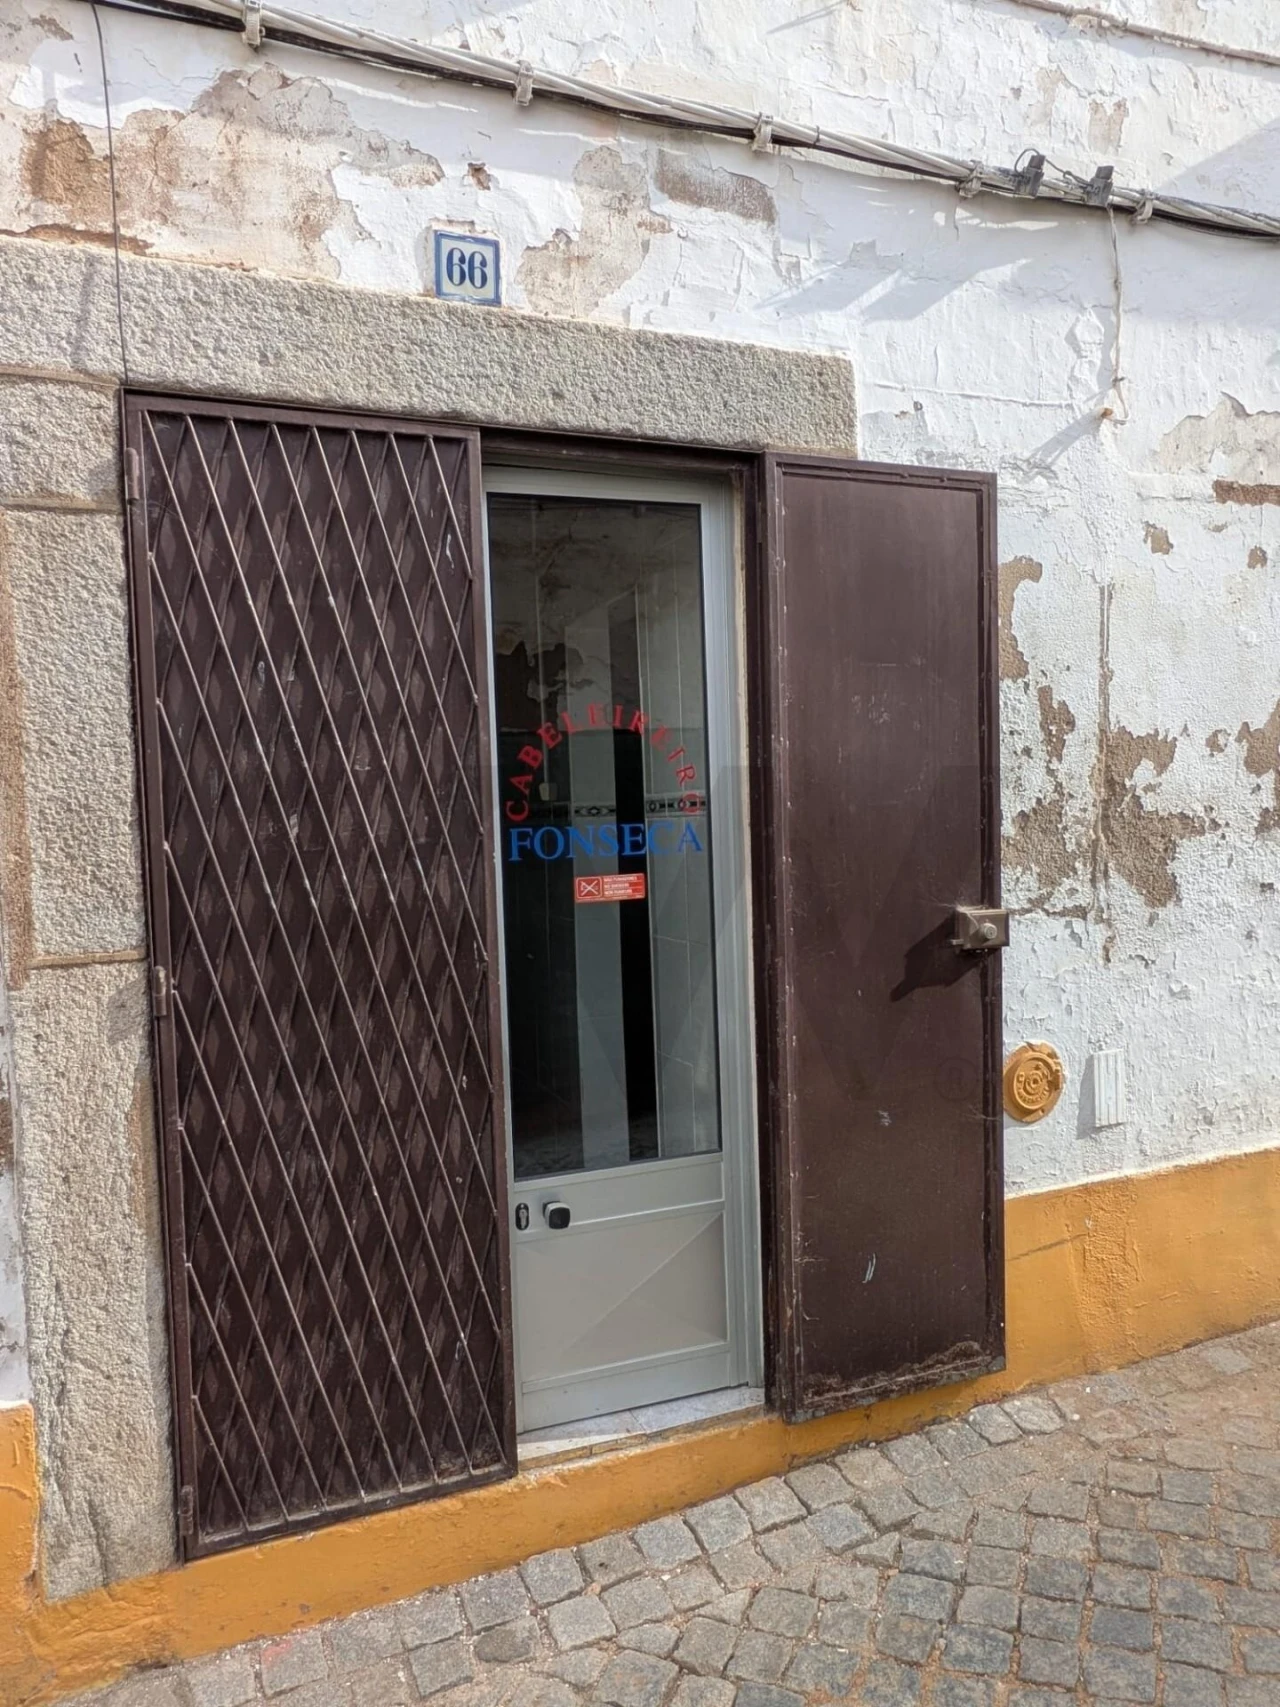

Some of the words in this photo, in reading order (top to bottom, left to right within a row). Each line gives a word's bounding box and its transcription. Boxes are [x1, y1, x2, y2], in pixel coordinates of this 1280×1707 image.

[446, 247, 488, 290] 66
[506, 703, 702, 822] CABELEIREIRO
[508, 821, 704, 862] FONSECA
